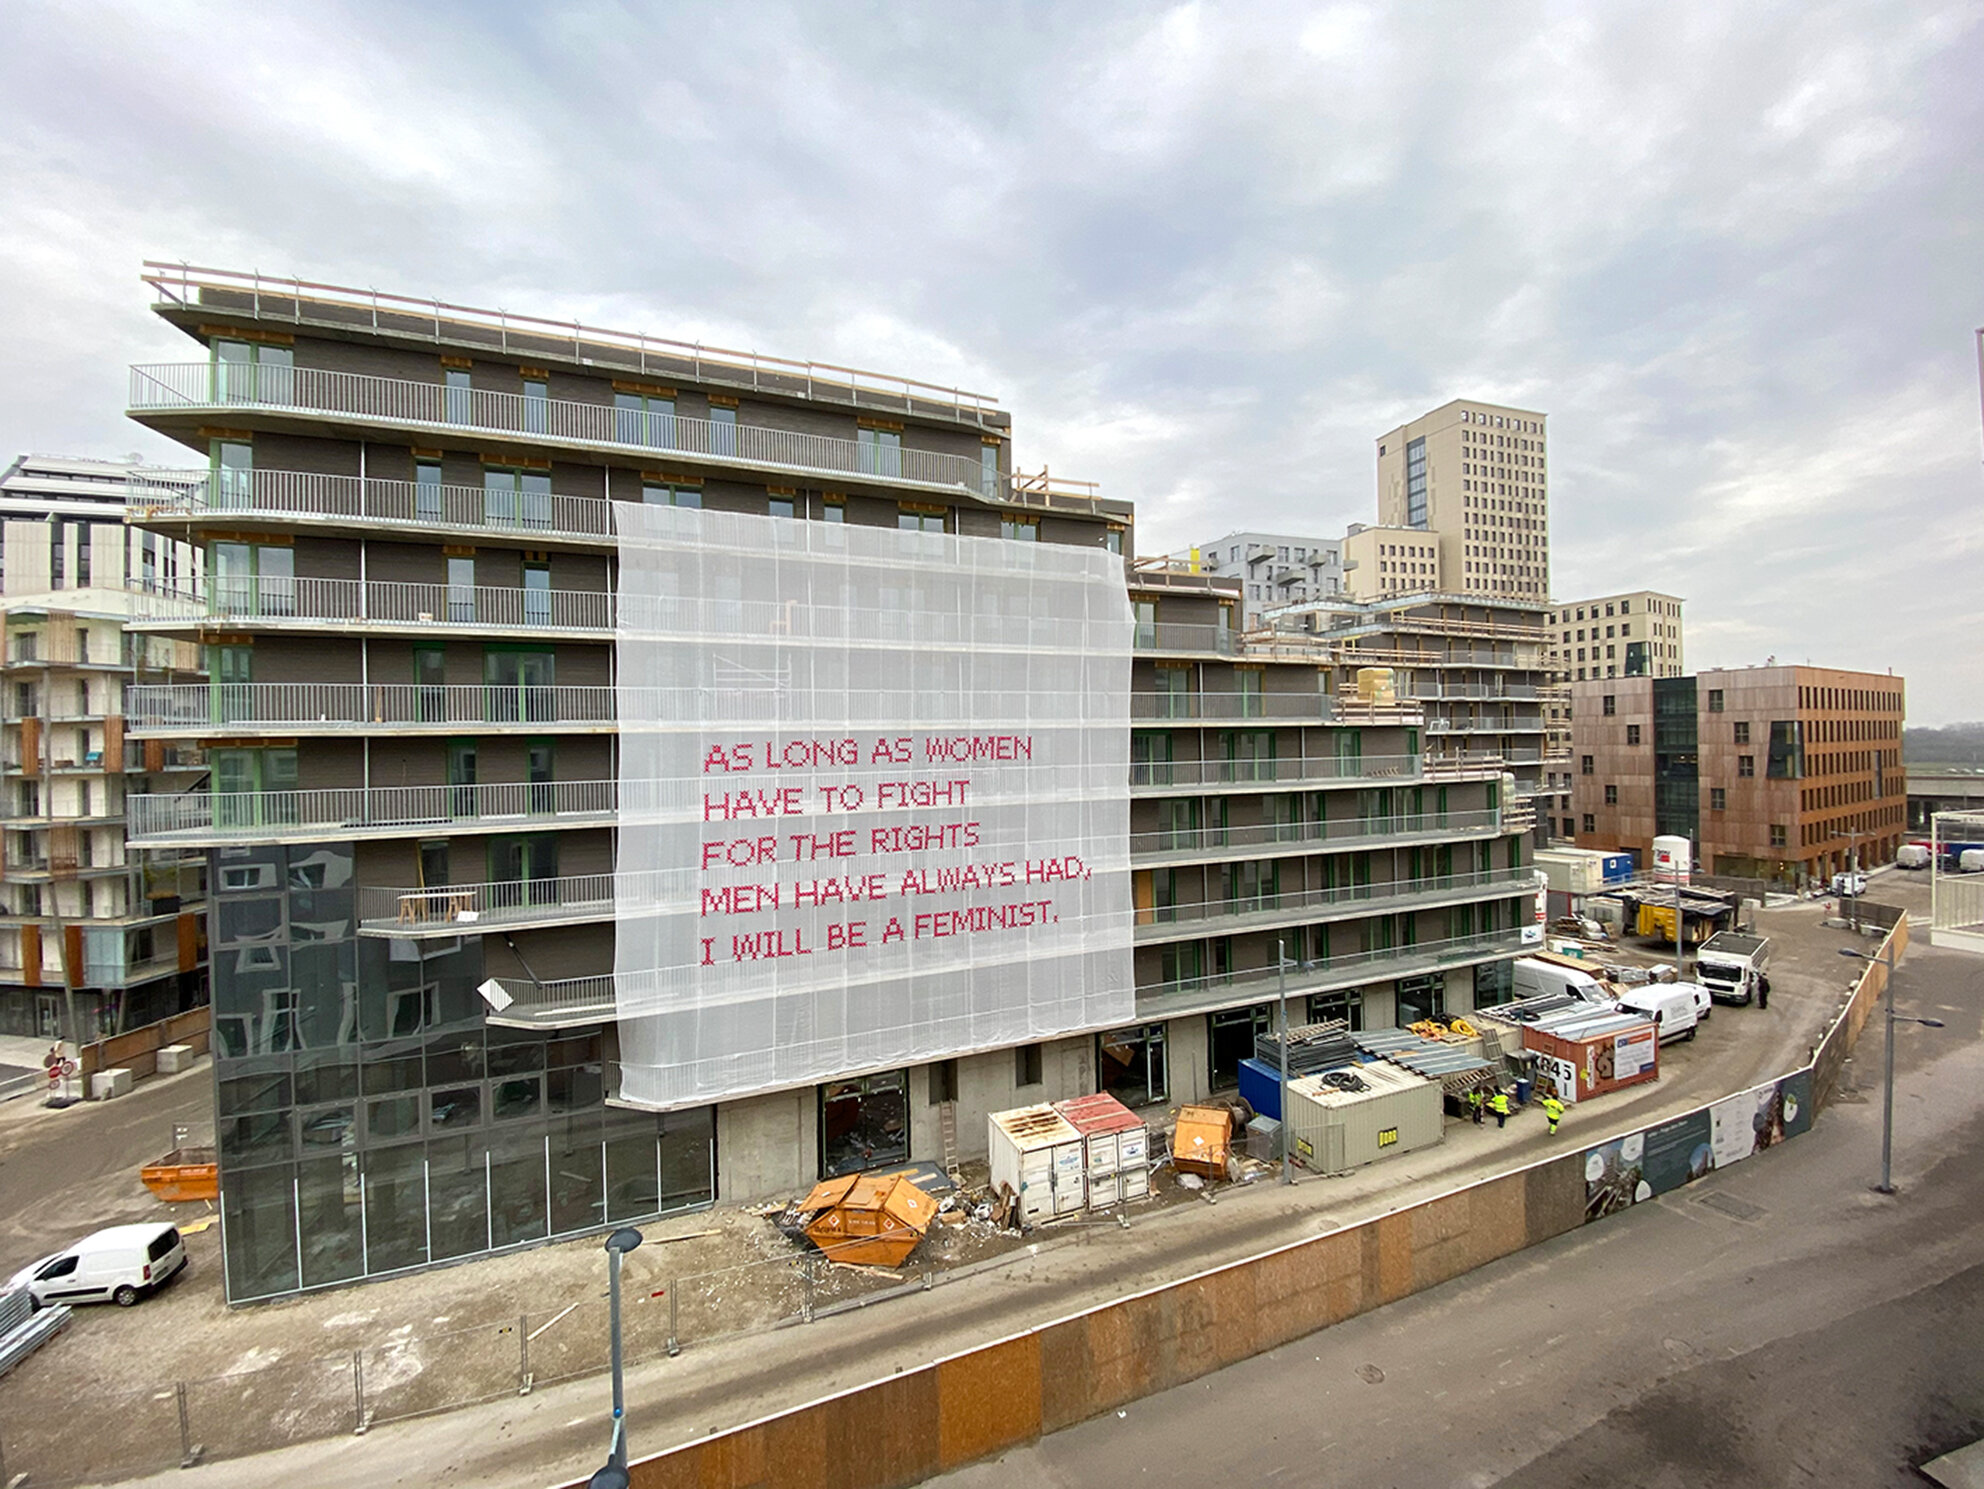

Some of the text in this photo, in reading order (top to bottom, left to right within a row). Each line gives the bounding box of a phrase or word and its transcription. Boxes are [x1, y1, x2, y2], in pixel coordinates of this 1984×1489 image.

[704, 736, 1032, 773] AS LONG AS WOMEN
[703, 780, 971, 821] HAVE TO FIGHT
[702, 822, 981, 871] FOR THE RIGHTS
[701, 856, 1092, 917] MEN HAVE ALWAYS HAD,
[700, 899, 1059, 966] I WILL BE A FEMINIST.
